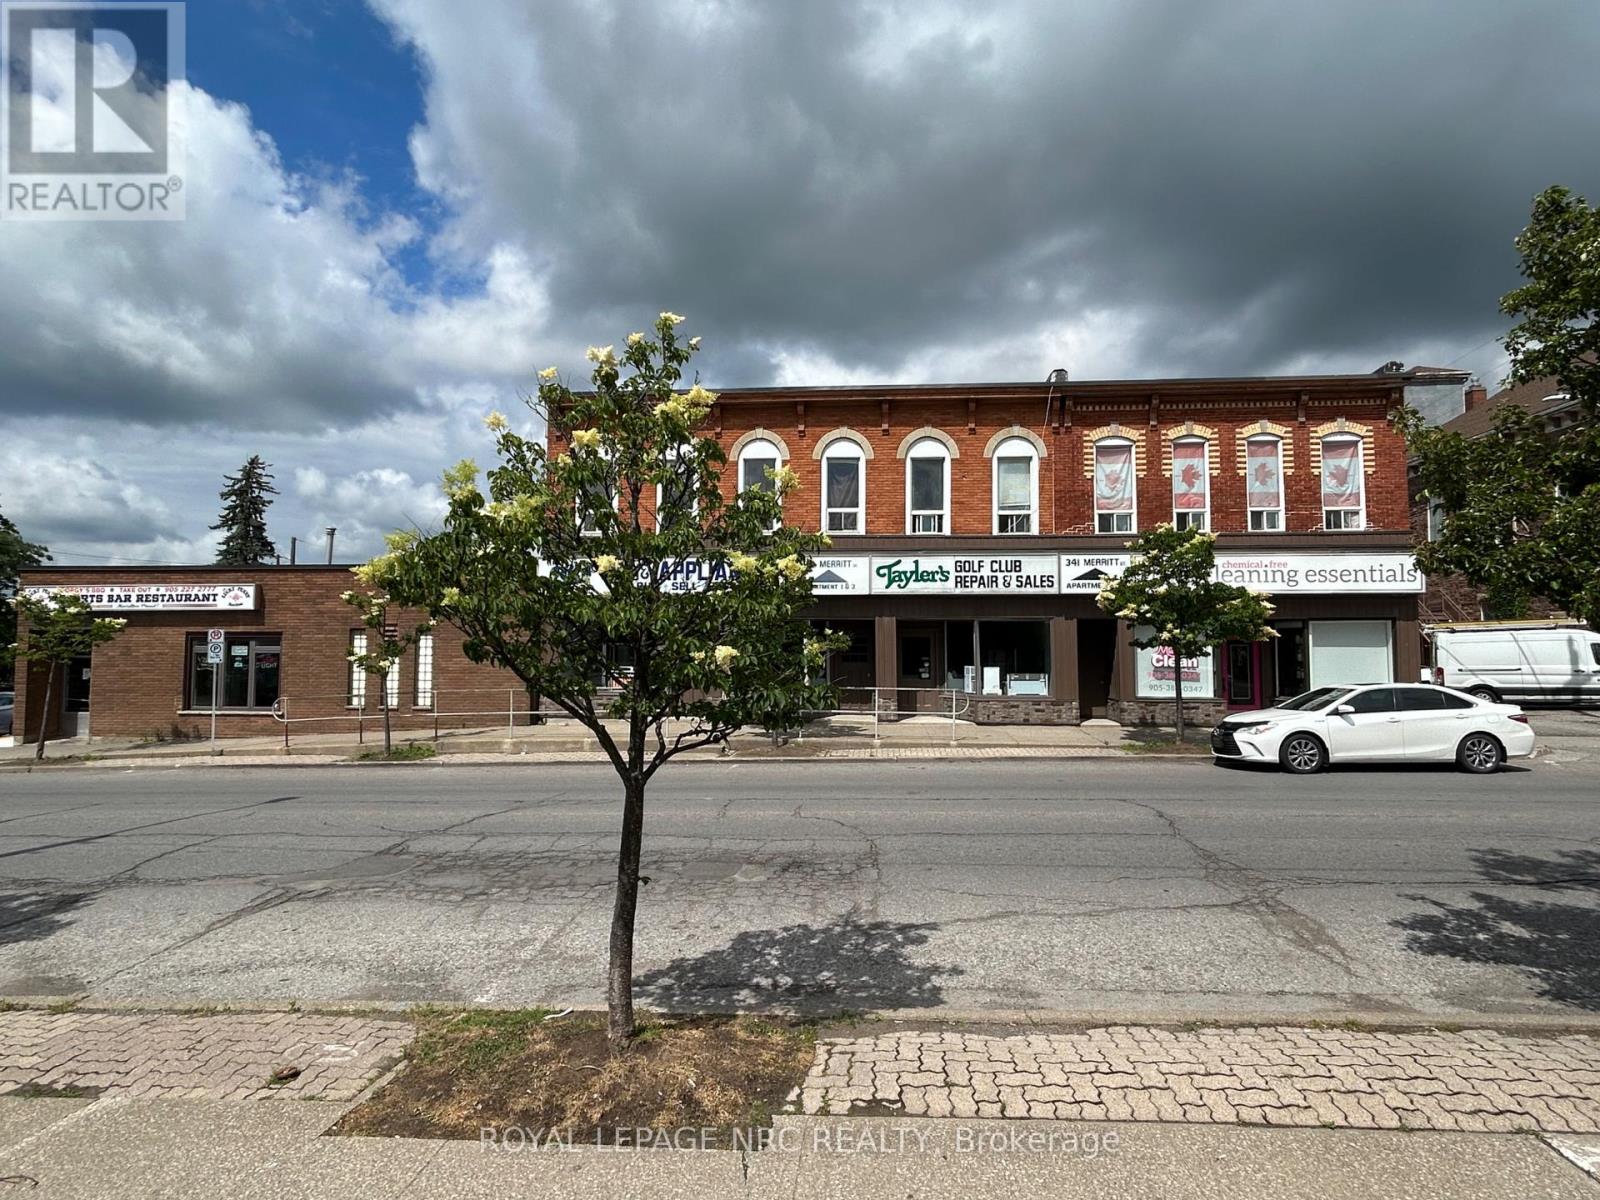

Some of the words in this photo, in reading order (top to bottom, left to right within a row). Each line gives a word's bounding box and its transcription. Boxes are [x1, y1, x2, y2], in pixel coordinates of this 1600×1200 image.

[821, 560, 852, 568] MERRITT
[954, 560, 984, 573] GOLF
[990, 560, 1022, 573] CLUB
[1083, 558, 1119, 567] MERRITT
[875, 559, 950, 589] Tayler's
[1211, 564, 1299, 588] leaning
[1304, 563, 1418, 583] essentials
[954, 576, 999, 588] REPAIR
[1002, 575, 1011, 588] &
[1015, 575, 1055, 588] SALES
[107, 594, 132, 603] BAR
[135, 593, 219, 603] RESTAURANT
[1151, 654, 1199, 669] Clean
